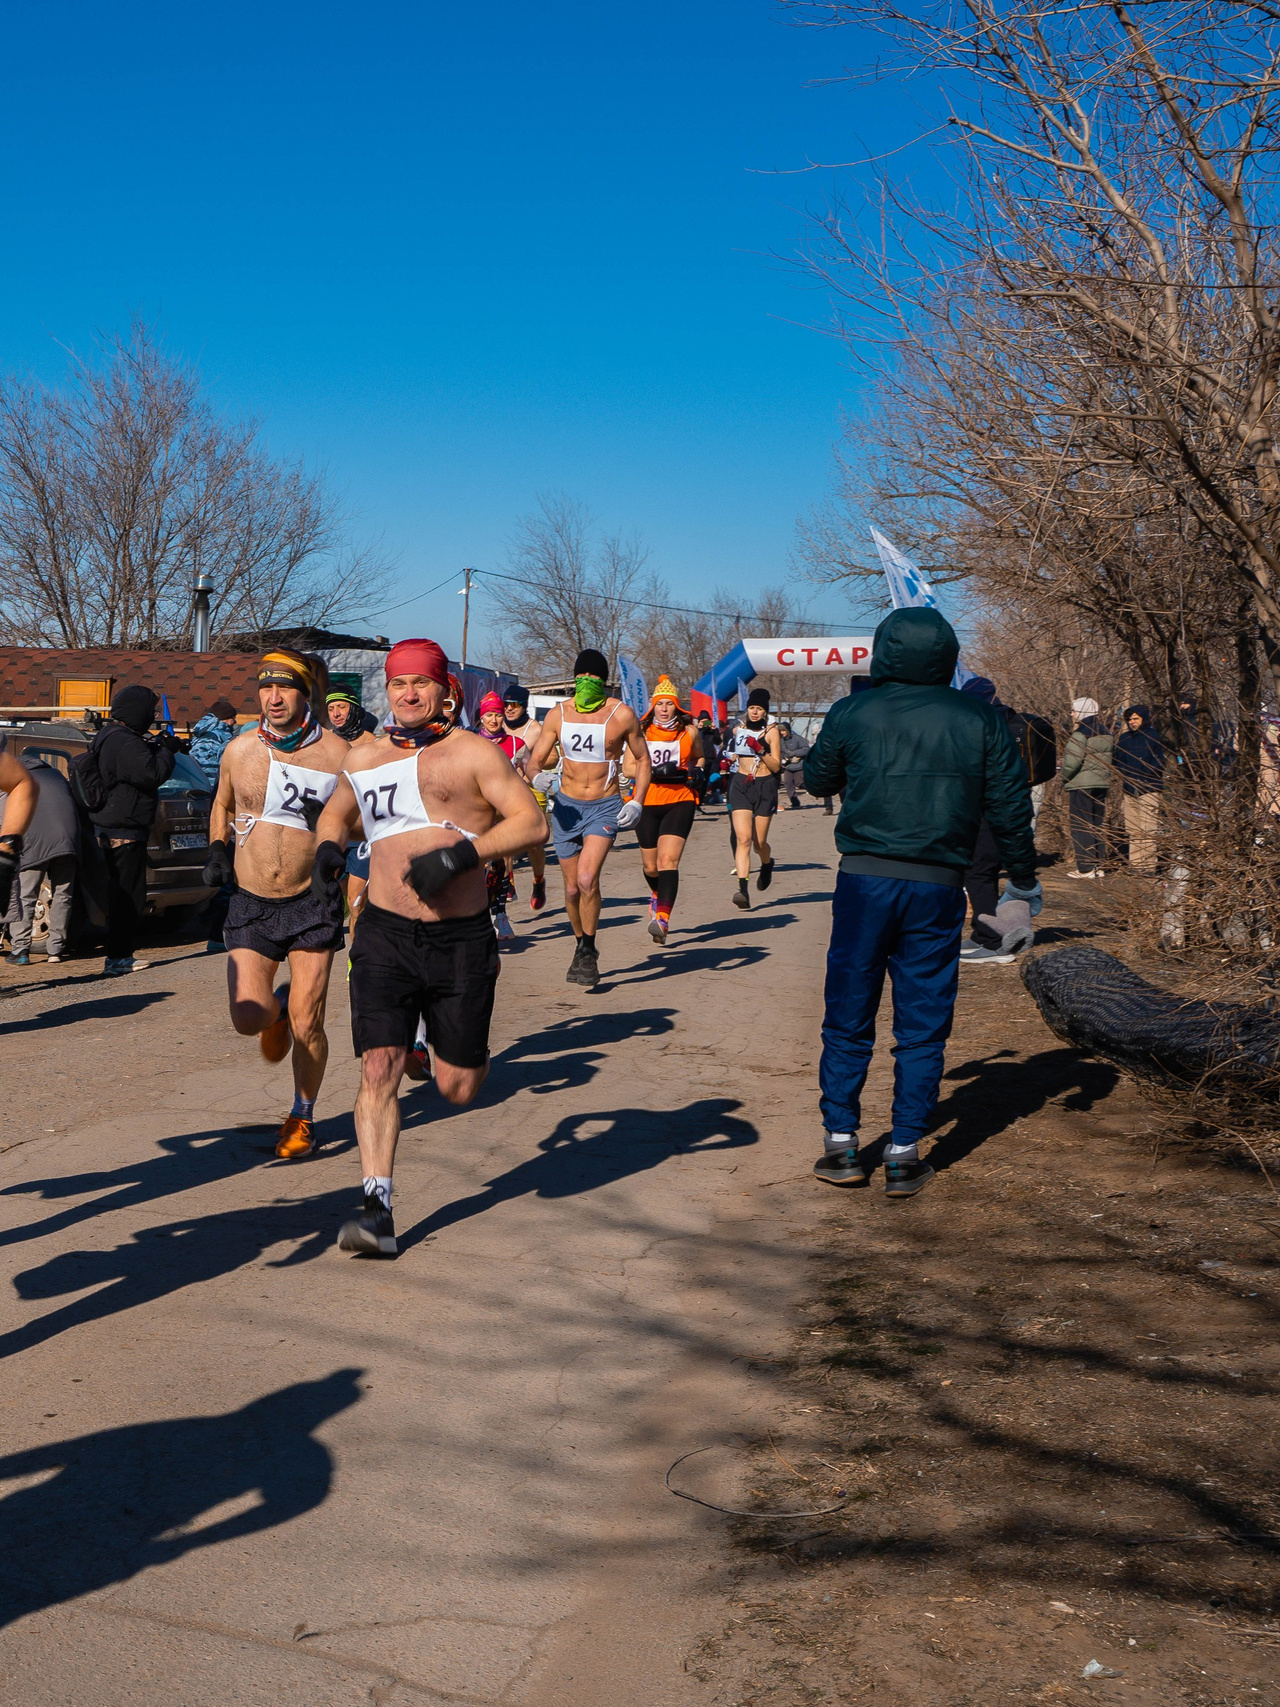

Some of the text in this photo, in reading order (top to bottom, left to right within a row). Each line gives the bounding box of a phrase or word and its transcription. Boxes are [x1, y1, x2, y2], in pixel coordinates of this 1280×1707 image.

[571, 733, 595, 753] 24
[652, 749, 672, 765] 30
[280, 782, 318, 814] 25
[363, 782, 398, 822] 27
